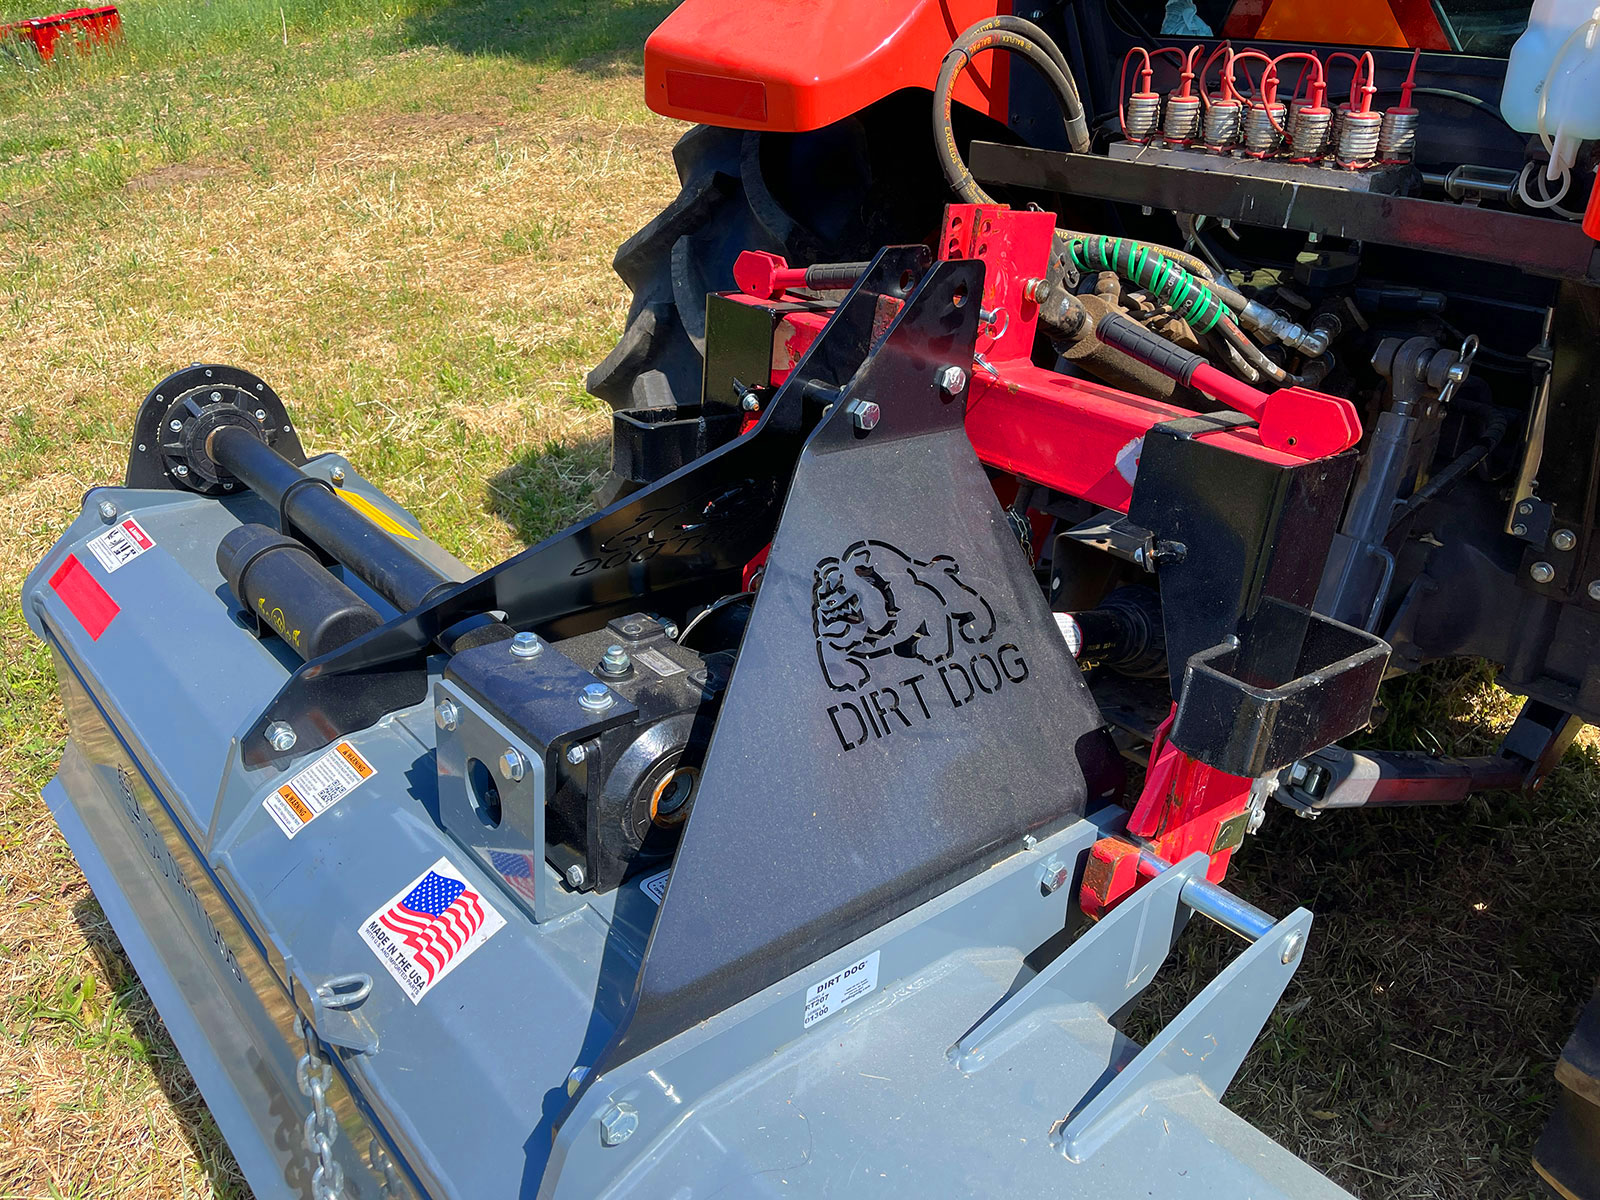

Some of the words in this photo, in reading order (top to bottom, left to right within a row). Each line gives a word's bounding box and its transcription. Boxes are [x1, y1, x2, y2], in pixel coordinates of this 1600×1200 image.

[1153, 246, 1186, 261] Resistant
[827, 673, 931, 752] DIRT
[938, 643, 1029, 708] DOG
[346, 751, 366, 773] WARNING
[287, 795, 307, 817] WARNING
[365, 928, 376, 940] WITH
[380, 946, 390, 958] AND
[388, 956, 408, 981] IMPORTED
[406, 979, 420, 996] PARTS
[368, 921, 390, 946] MADE
[386, 943, 398, 956] IN
[395, 952, 412, 973] THE
[409, 969, 426, 991] USA
[816, 974, 842, 994] DIRT
[844, 961, 867, 979] DOG
